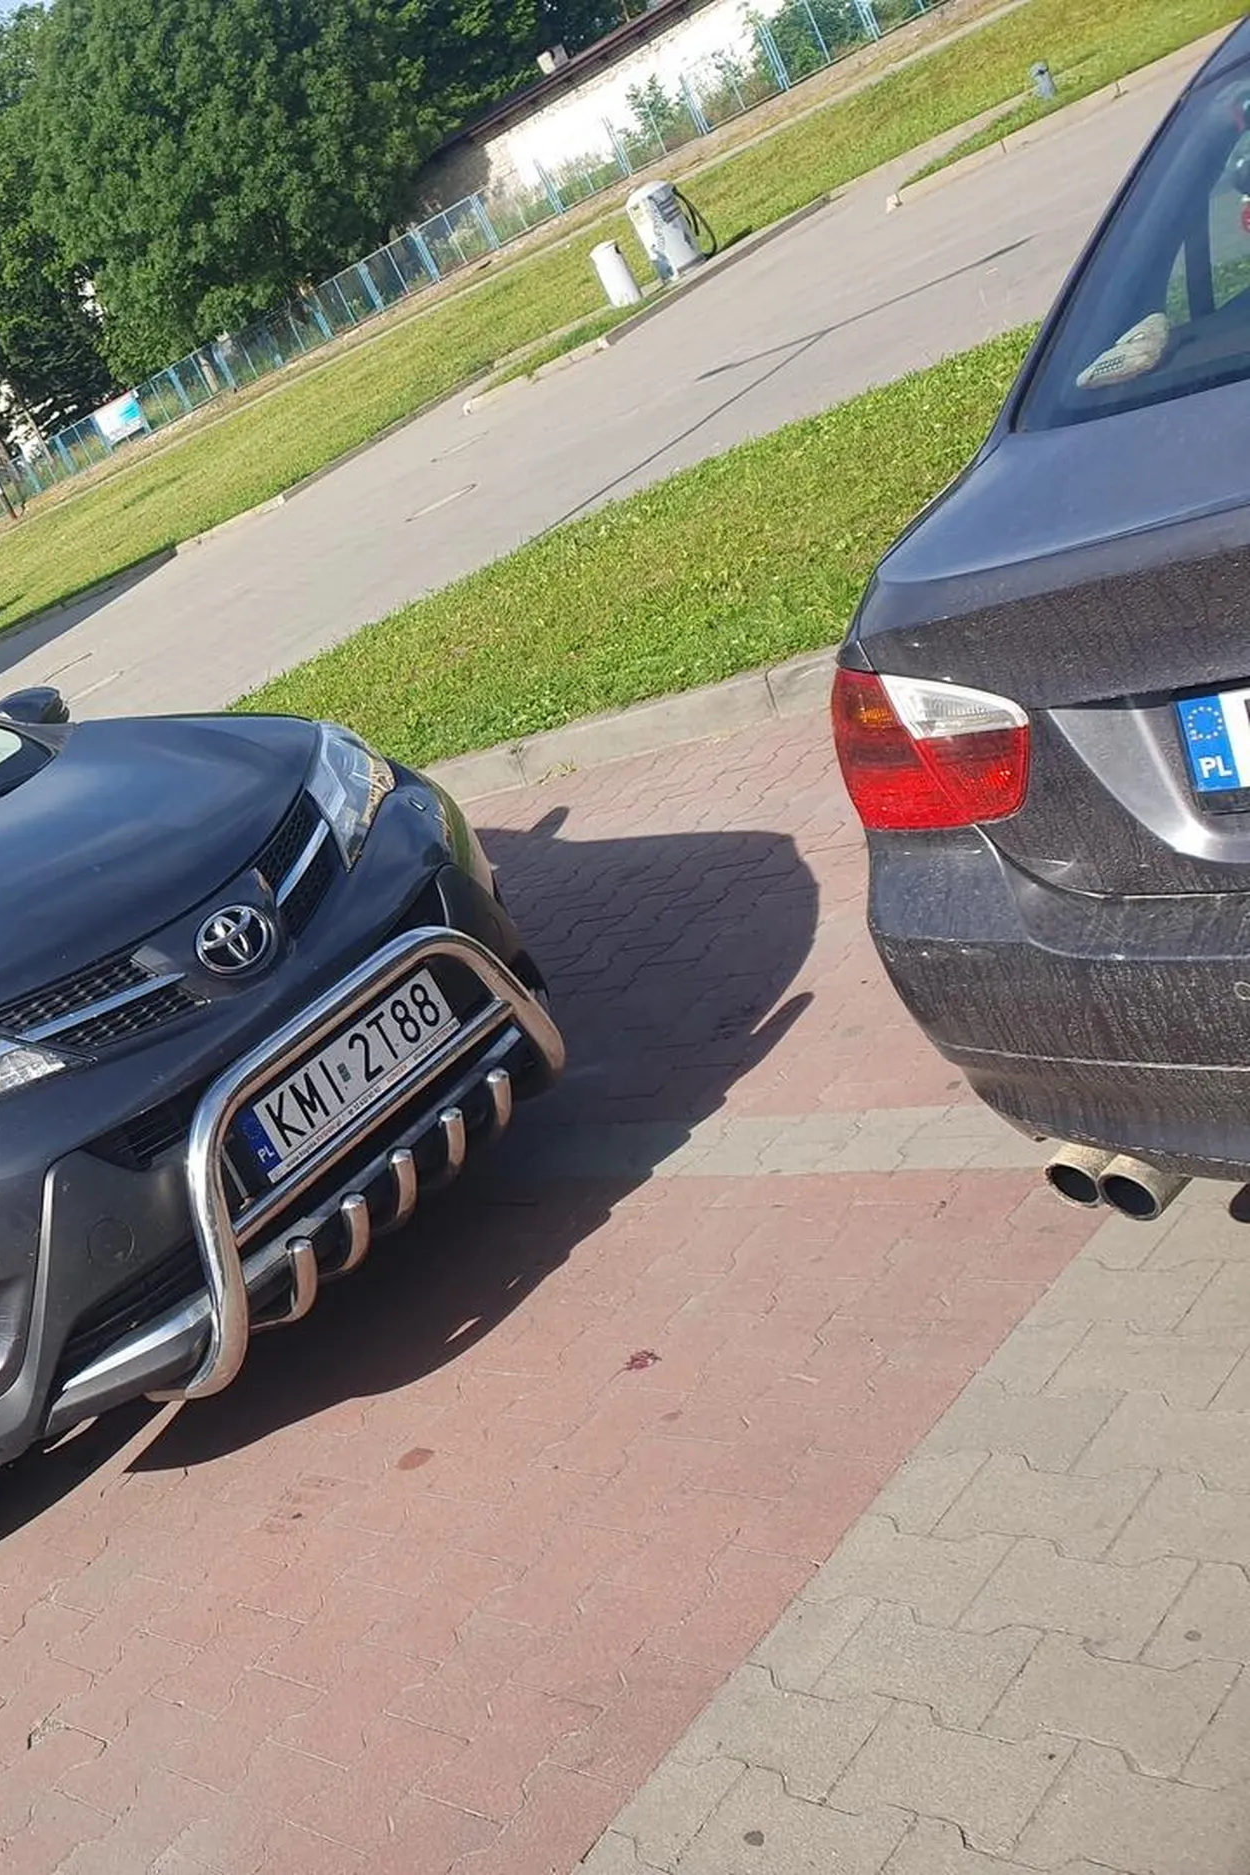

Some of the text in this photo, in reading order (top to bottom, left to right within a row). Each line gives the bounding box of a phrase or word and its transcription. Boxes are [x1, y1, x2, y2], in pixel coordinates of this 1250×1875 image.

[1199, 755, 1232, 779] PL
[265, 1060, 345, 1148] KMI
[348, 983, 440, 1083] 2T88
[257, 1146, 275, 1163] PL
